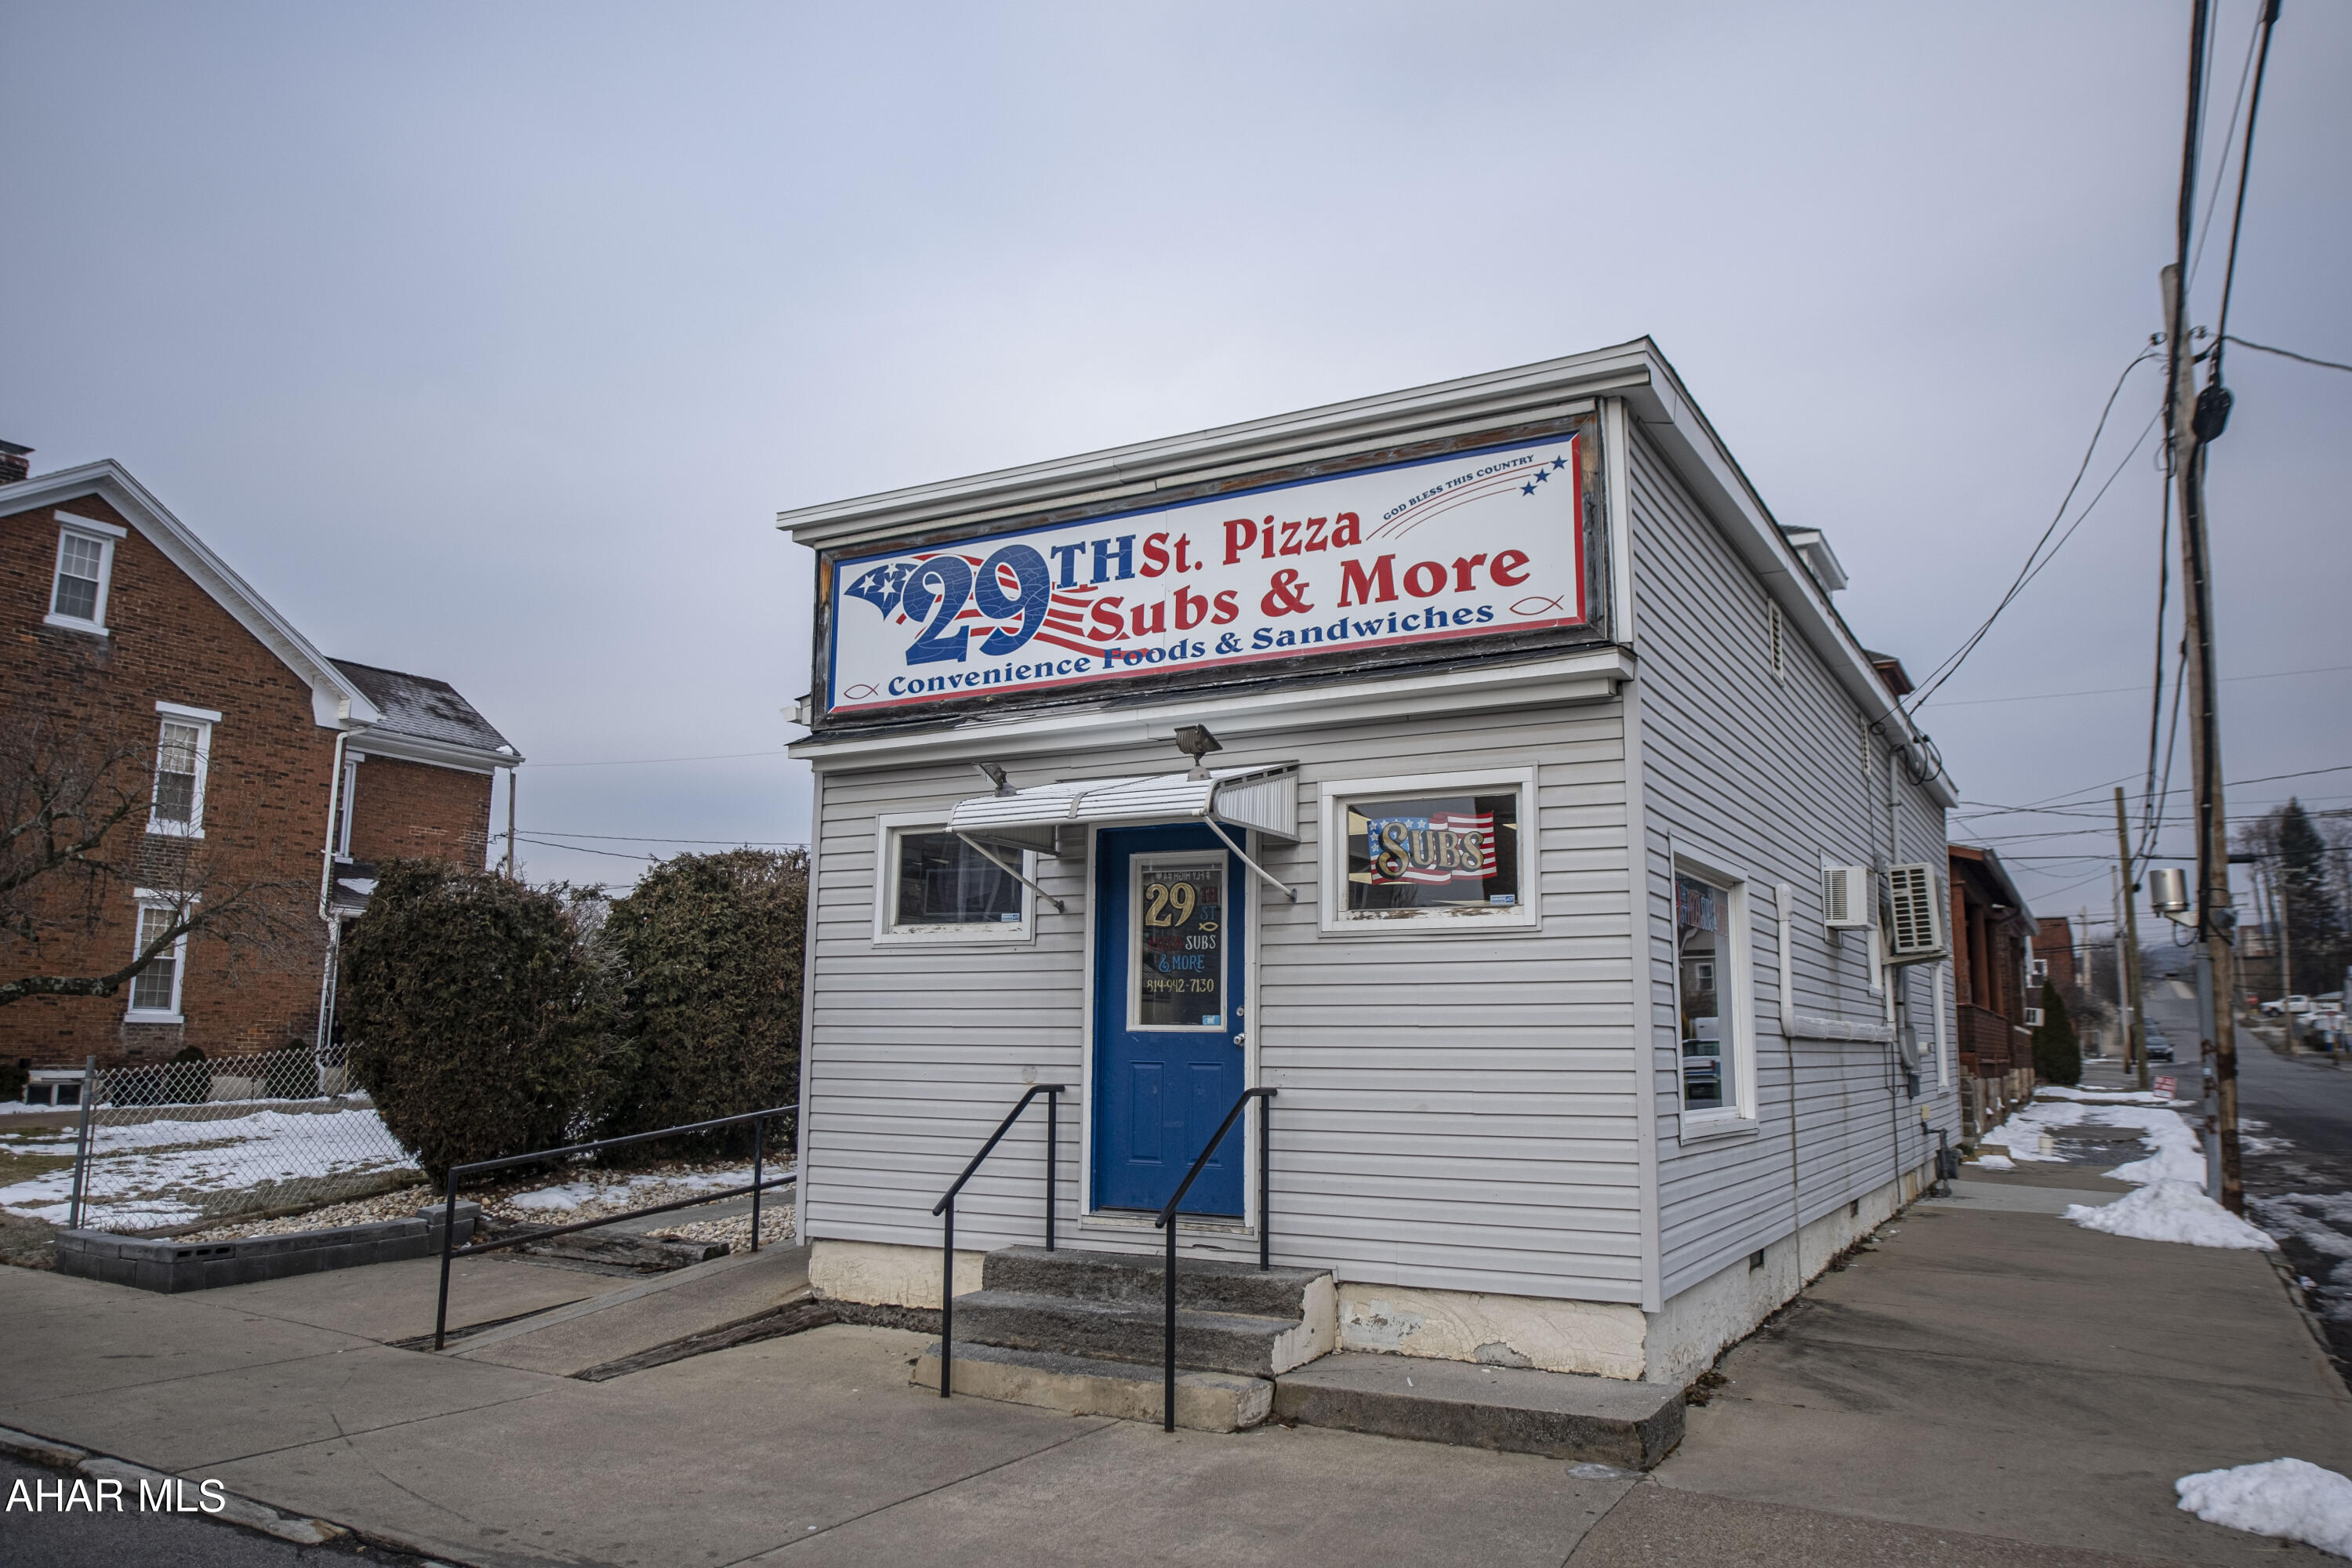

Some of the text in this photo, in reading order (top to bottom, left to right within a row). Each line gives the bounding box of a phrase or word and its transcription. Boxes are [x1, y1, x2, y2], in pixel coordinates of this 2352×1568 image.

[1383, 455, 1534, 520] GOD BLESS THIS COUNTRY
[902, 544, 1051, 666] 29
[1139, 532, 1203, 577] St.
[1223, 511, 1361, 565] Pizza
[1087, 549, 1530, 641] Subs & More
[887, 604, 1494, 696] Convenience Foods & Sandwiches
[1145, 882, 1196, 927] 29
[1200, 906, 1217, 920] ST
[1158, 955, 1205, 973] & MORE
[1185, 935, 1216, 950] SUBS
[1146, 978, 1214, 993] 814-942-7130
